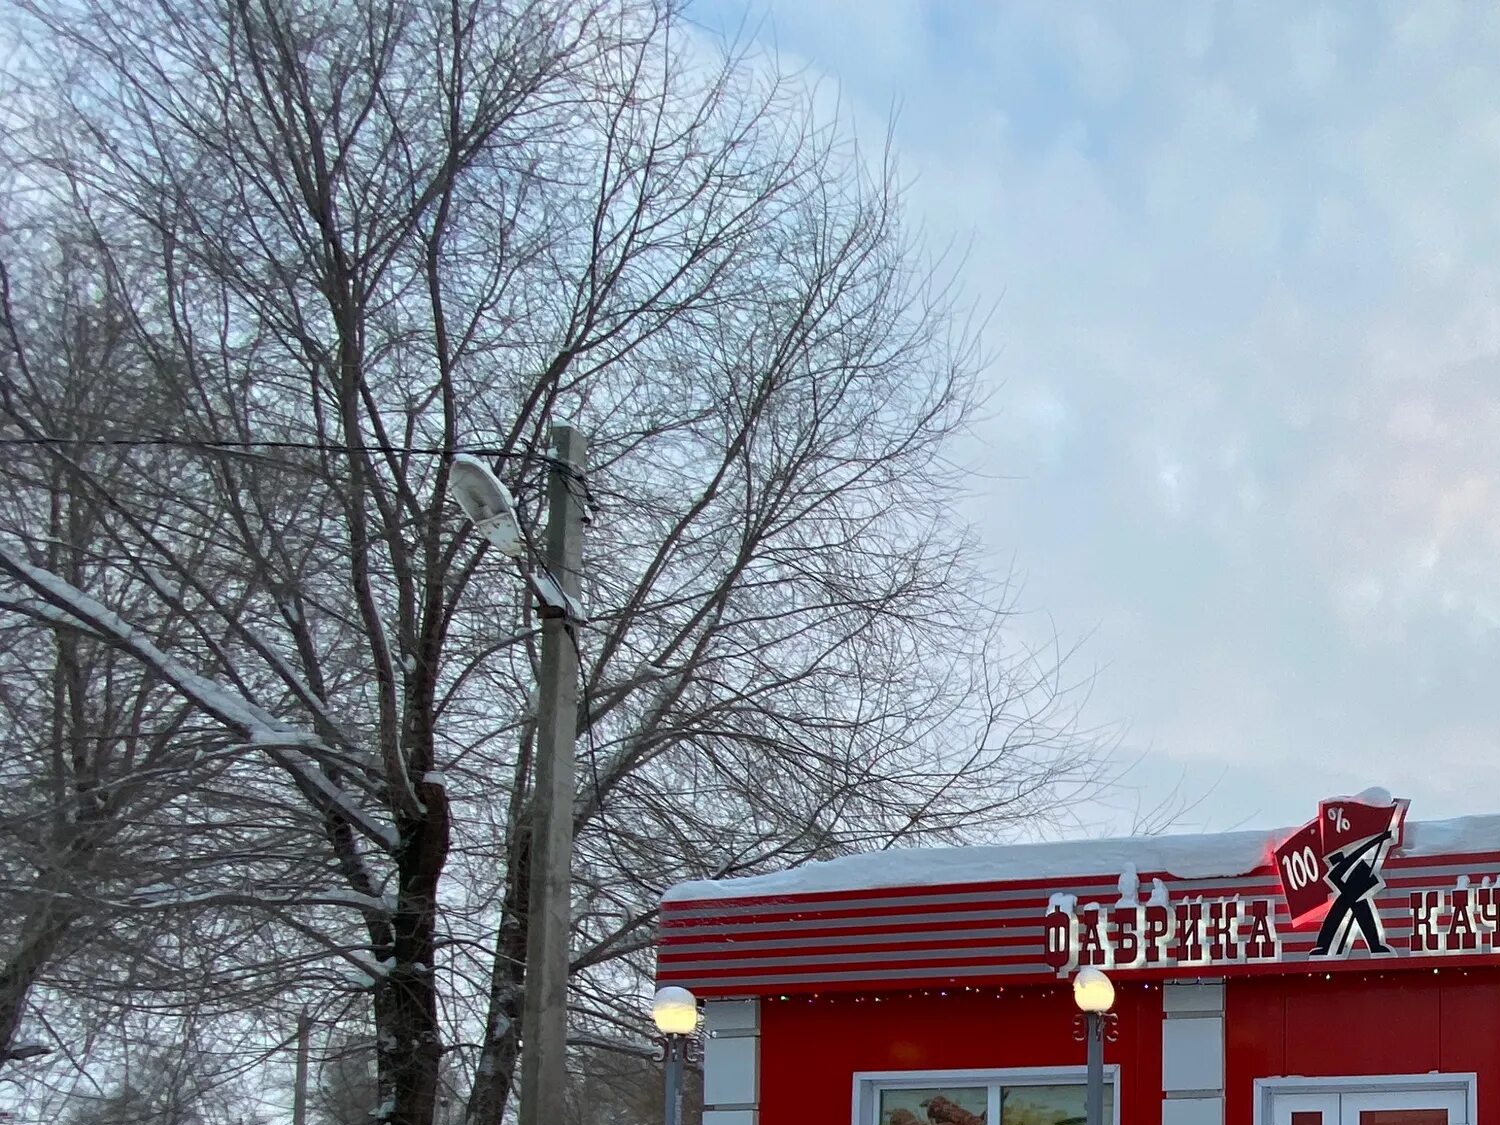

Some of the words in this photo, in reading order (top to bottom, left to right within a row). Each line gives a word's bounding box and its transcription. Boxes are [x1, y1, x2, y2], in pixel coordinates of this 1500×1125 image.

[1281, 845, 1319, 891] 100
[1327, 806, 1350, 833] %
[1045, 899, 1280, 977] ФАБРИКА
